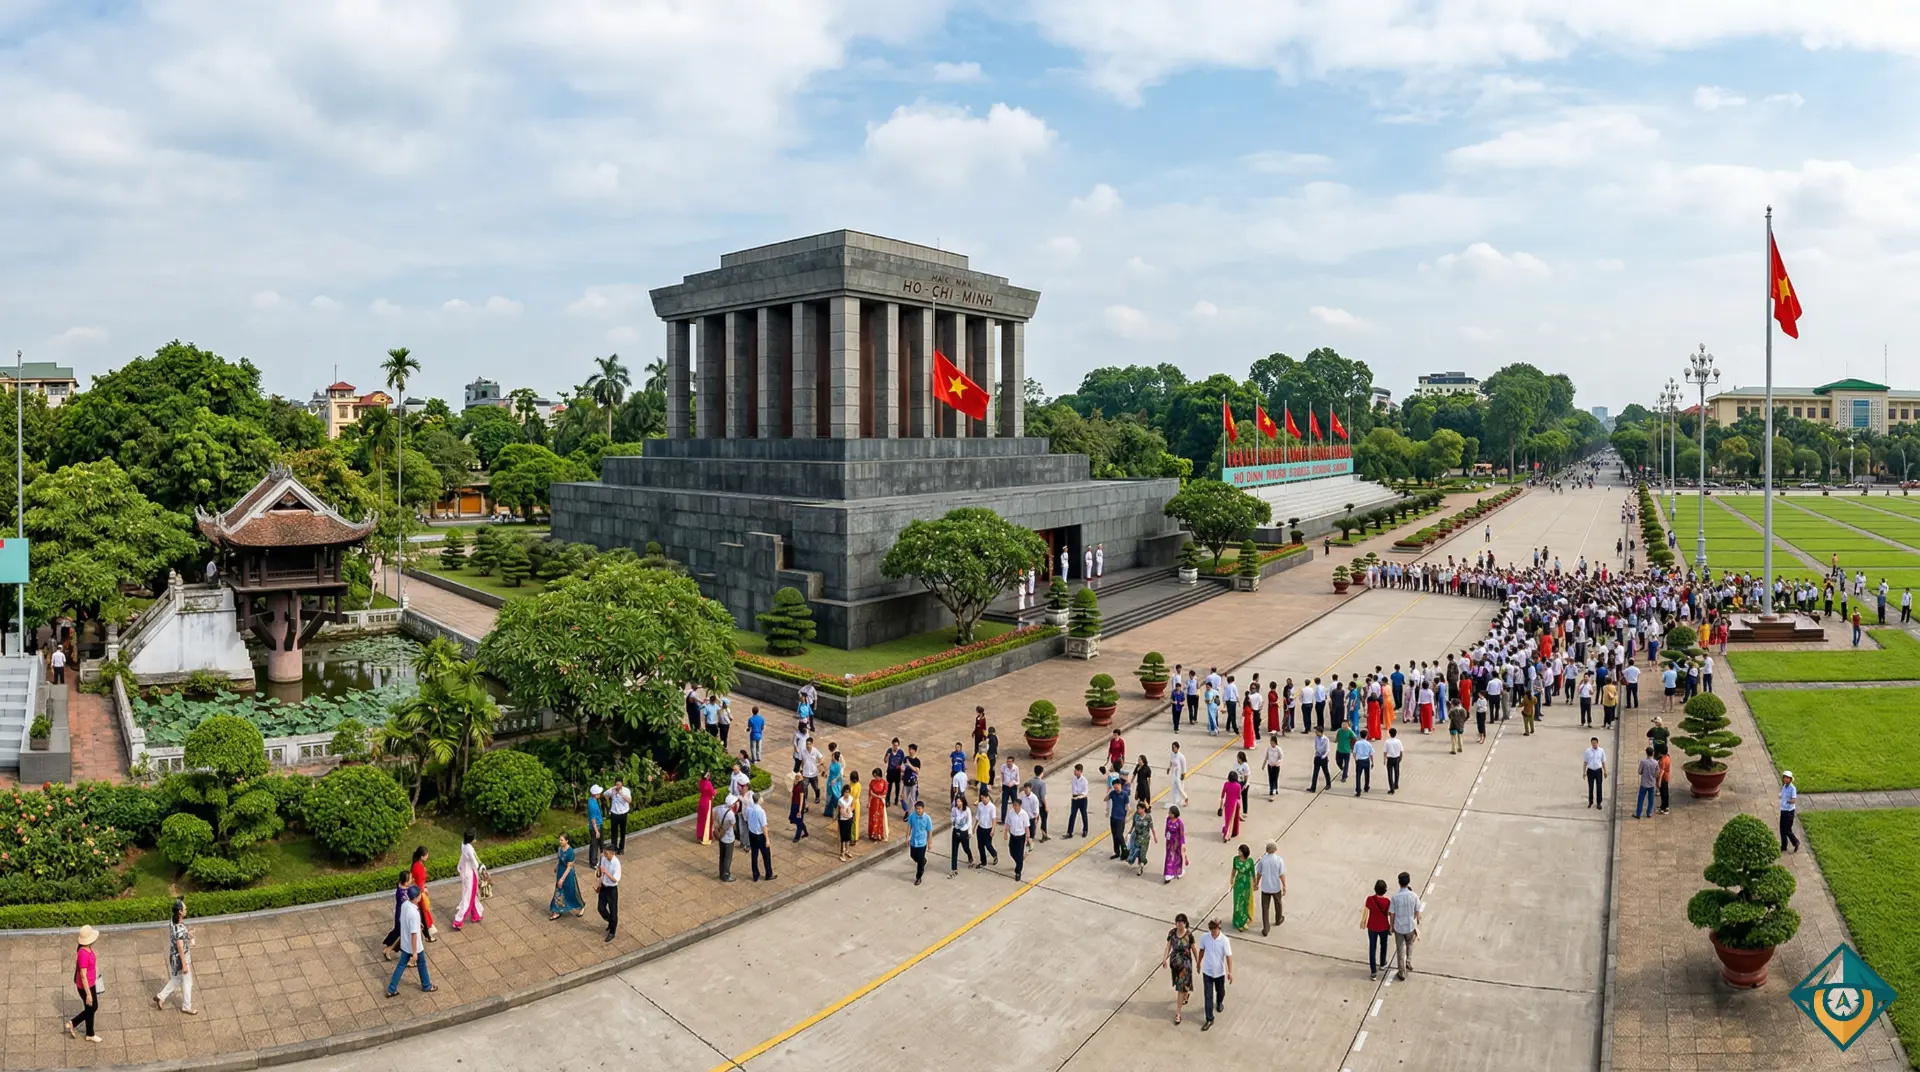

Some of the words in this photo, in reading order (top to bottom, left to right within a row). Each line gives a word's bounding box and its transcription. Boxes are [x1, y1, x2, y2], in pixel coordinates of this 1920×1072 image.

[903, 280, 922, 294] HO
[932, 285, 953, 300] CHI
[962, 290, 993, 306] MINH
